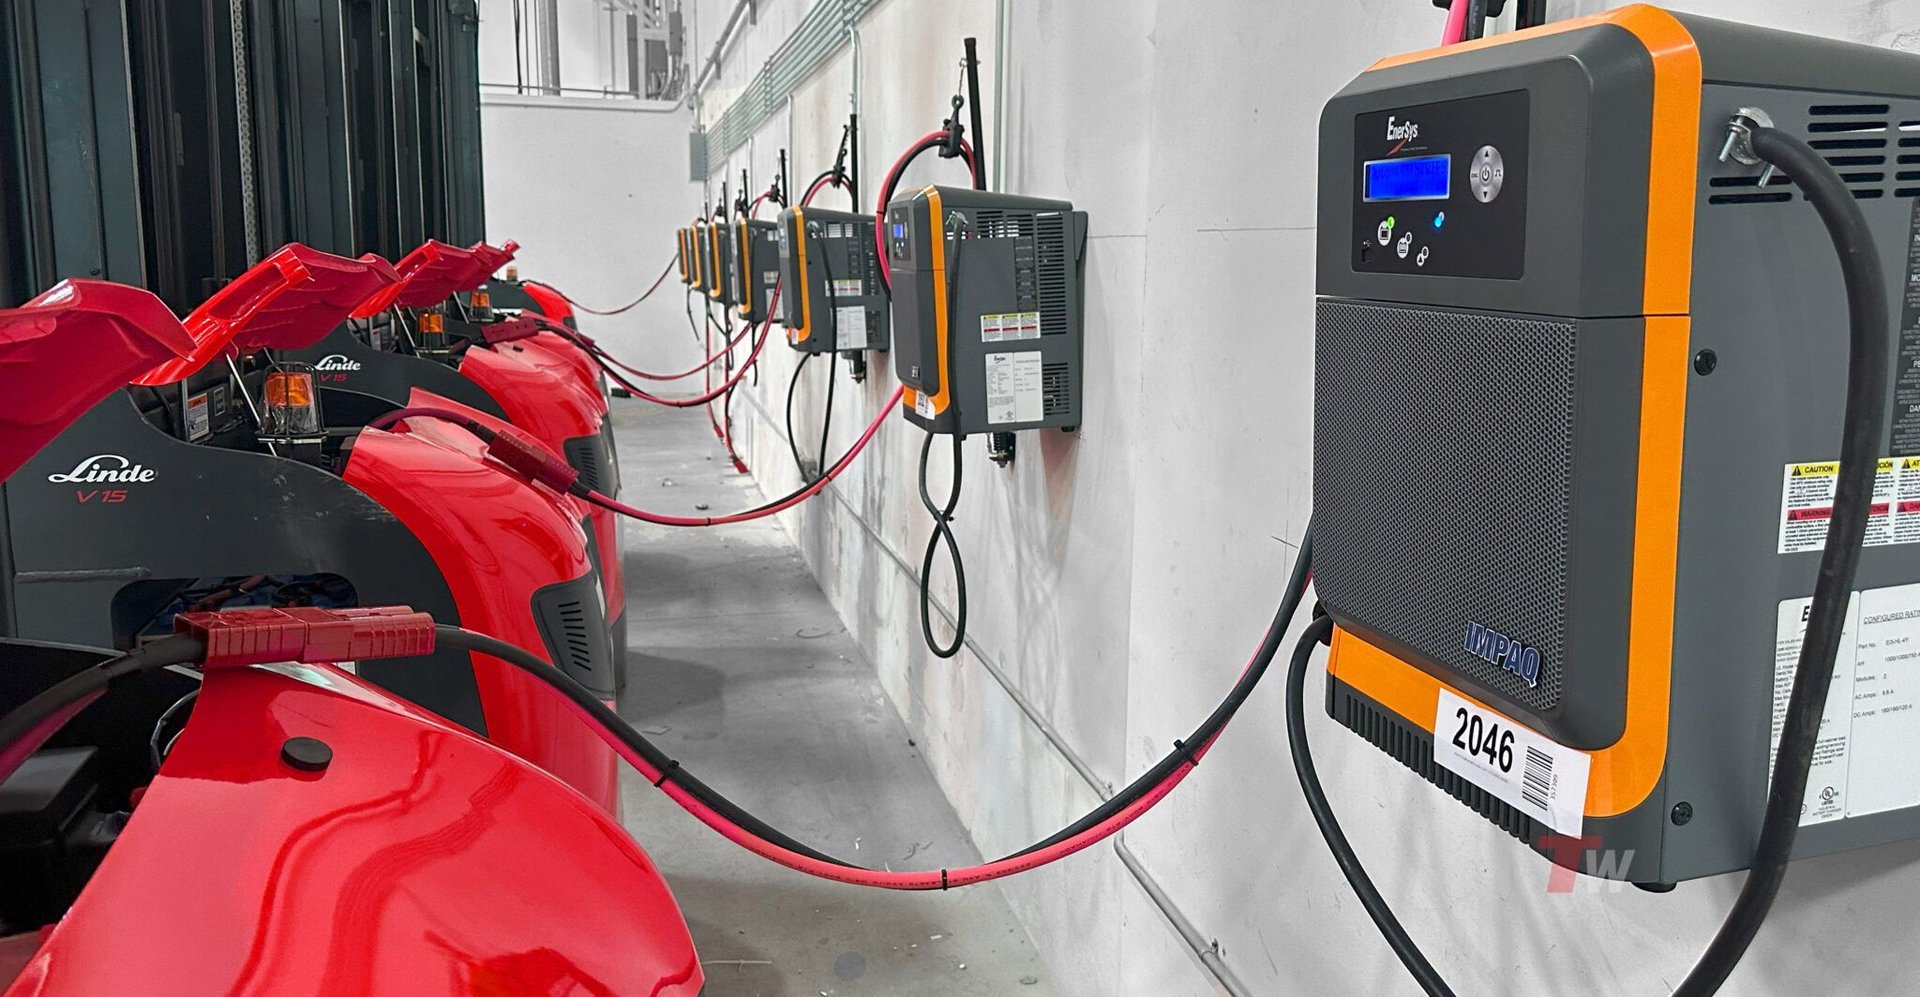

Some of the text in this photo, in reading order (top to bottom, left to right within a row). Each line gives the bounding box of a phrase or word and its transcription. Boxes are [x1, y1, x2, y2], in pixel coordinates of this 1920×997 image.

[1386, 115, 1418, 142] EnerSys
[305, 354, 361, 371] Linde
[48, 454, 155, 483] Linde
[1804, 465, 1834, 474] CAUTION
[76, 490, 128, 503] V 15
[1863, 612, 1904, 624] CONFIGURED
[1464, 622, 1542, 688] IMPAQ
[1452, 707, 1515, 773] 2046
